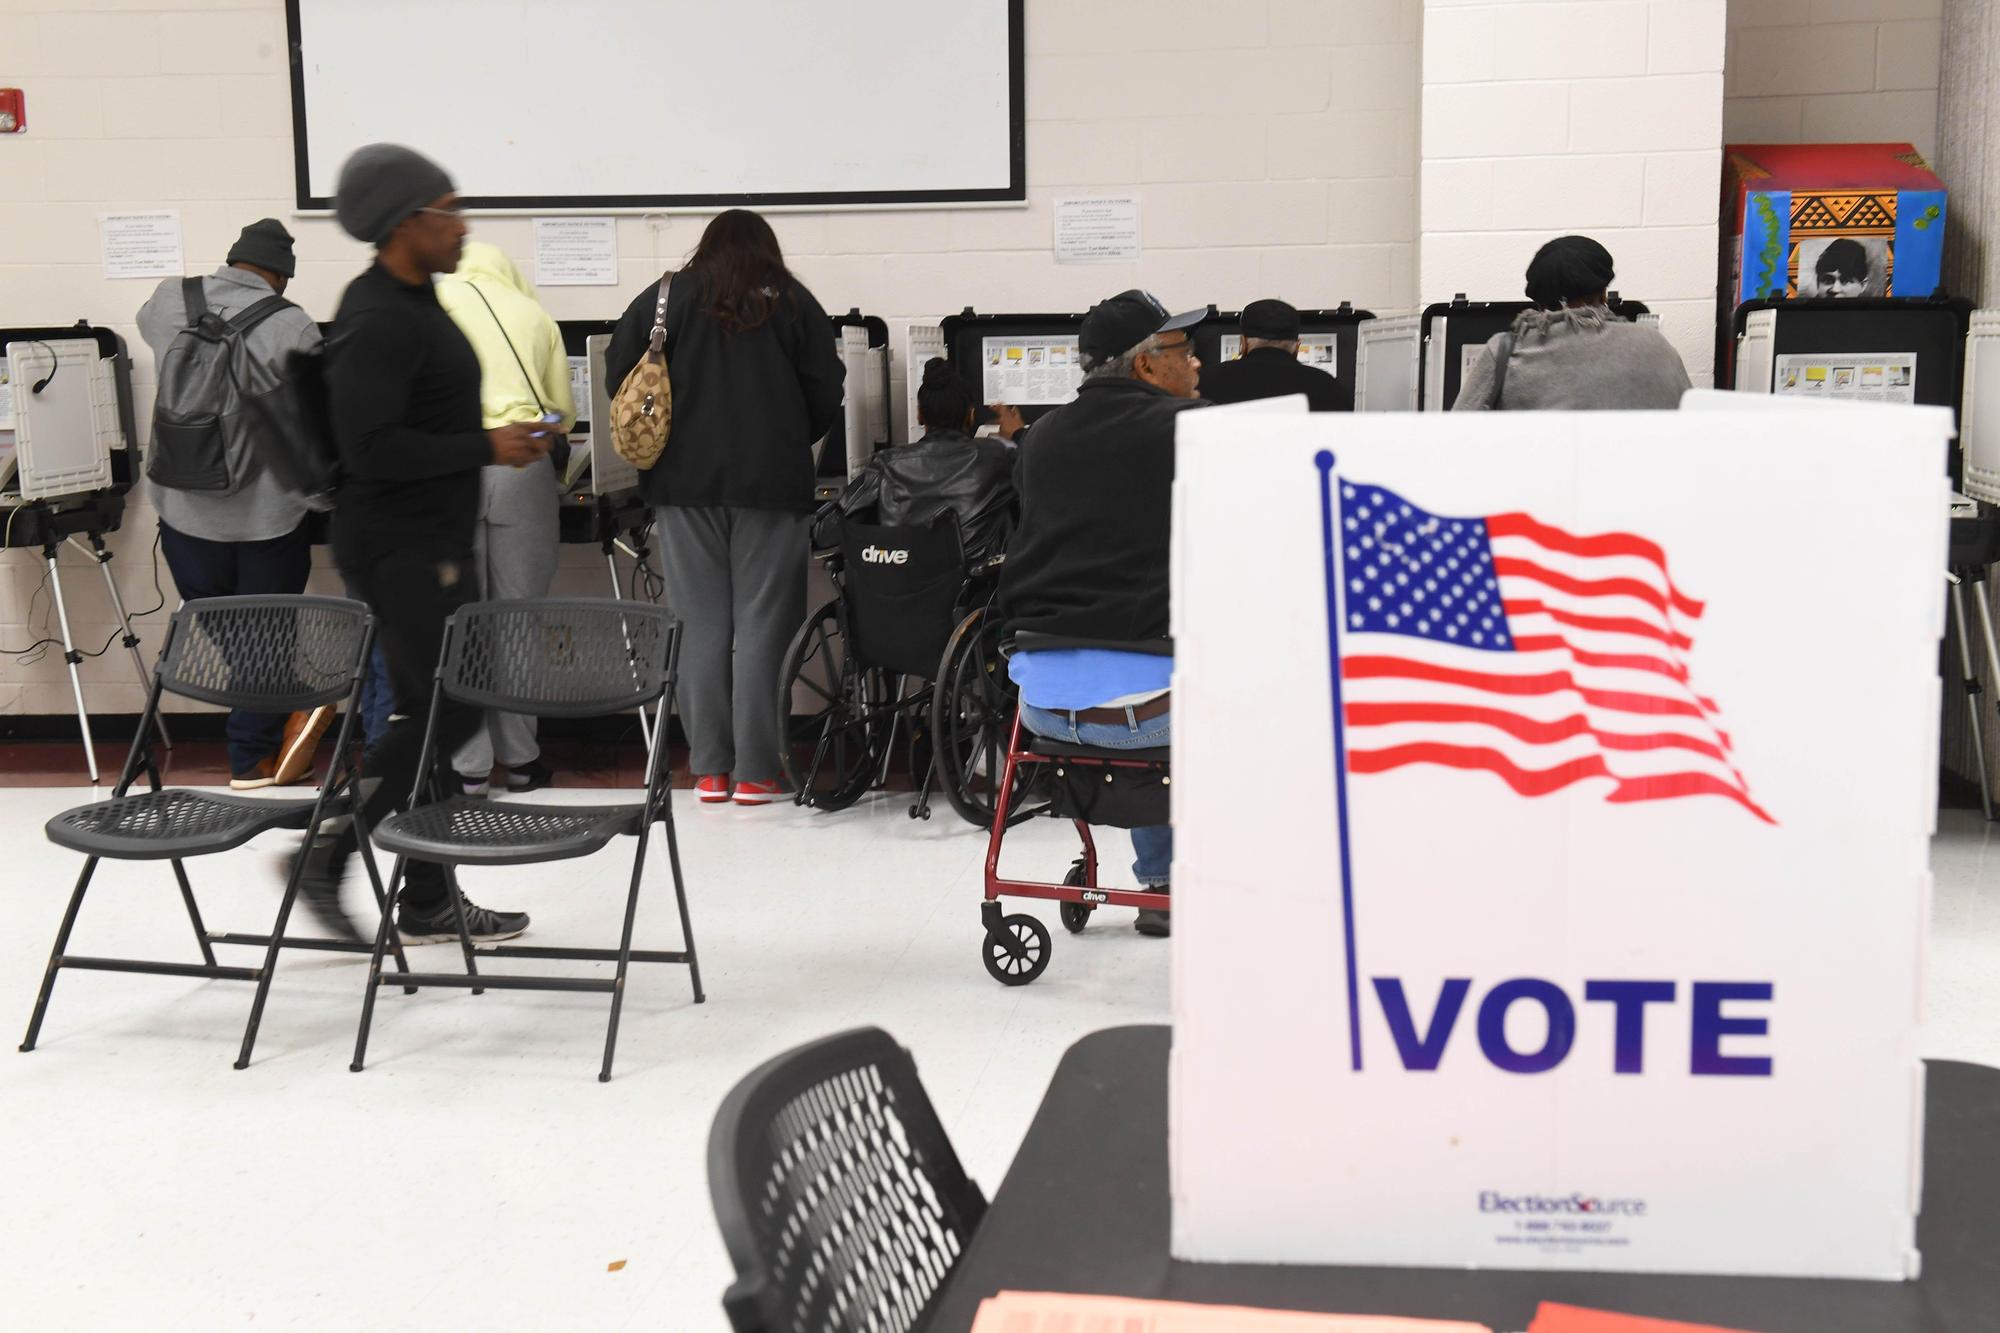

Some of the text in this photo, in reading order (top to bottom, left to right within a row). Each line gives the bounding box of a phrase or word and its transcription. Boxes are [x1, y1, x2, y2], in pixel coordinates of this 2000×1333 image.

[862, 545, 909, 564] drive
[1083, 891, 1106, 902] drive
[1371, 977, 1774, 1076] VOTE
[1479, 1191, 1647, 1215] ElectionSource
